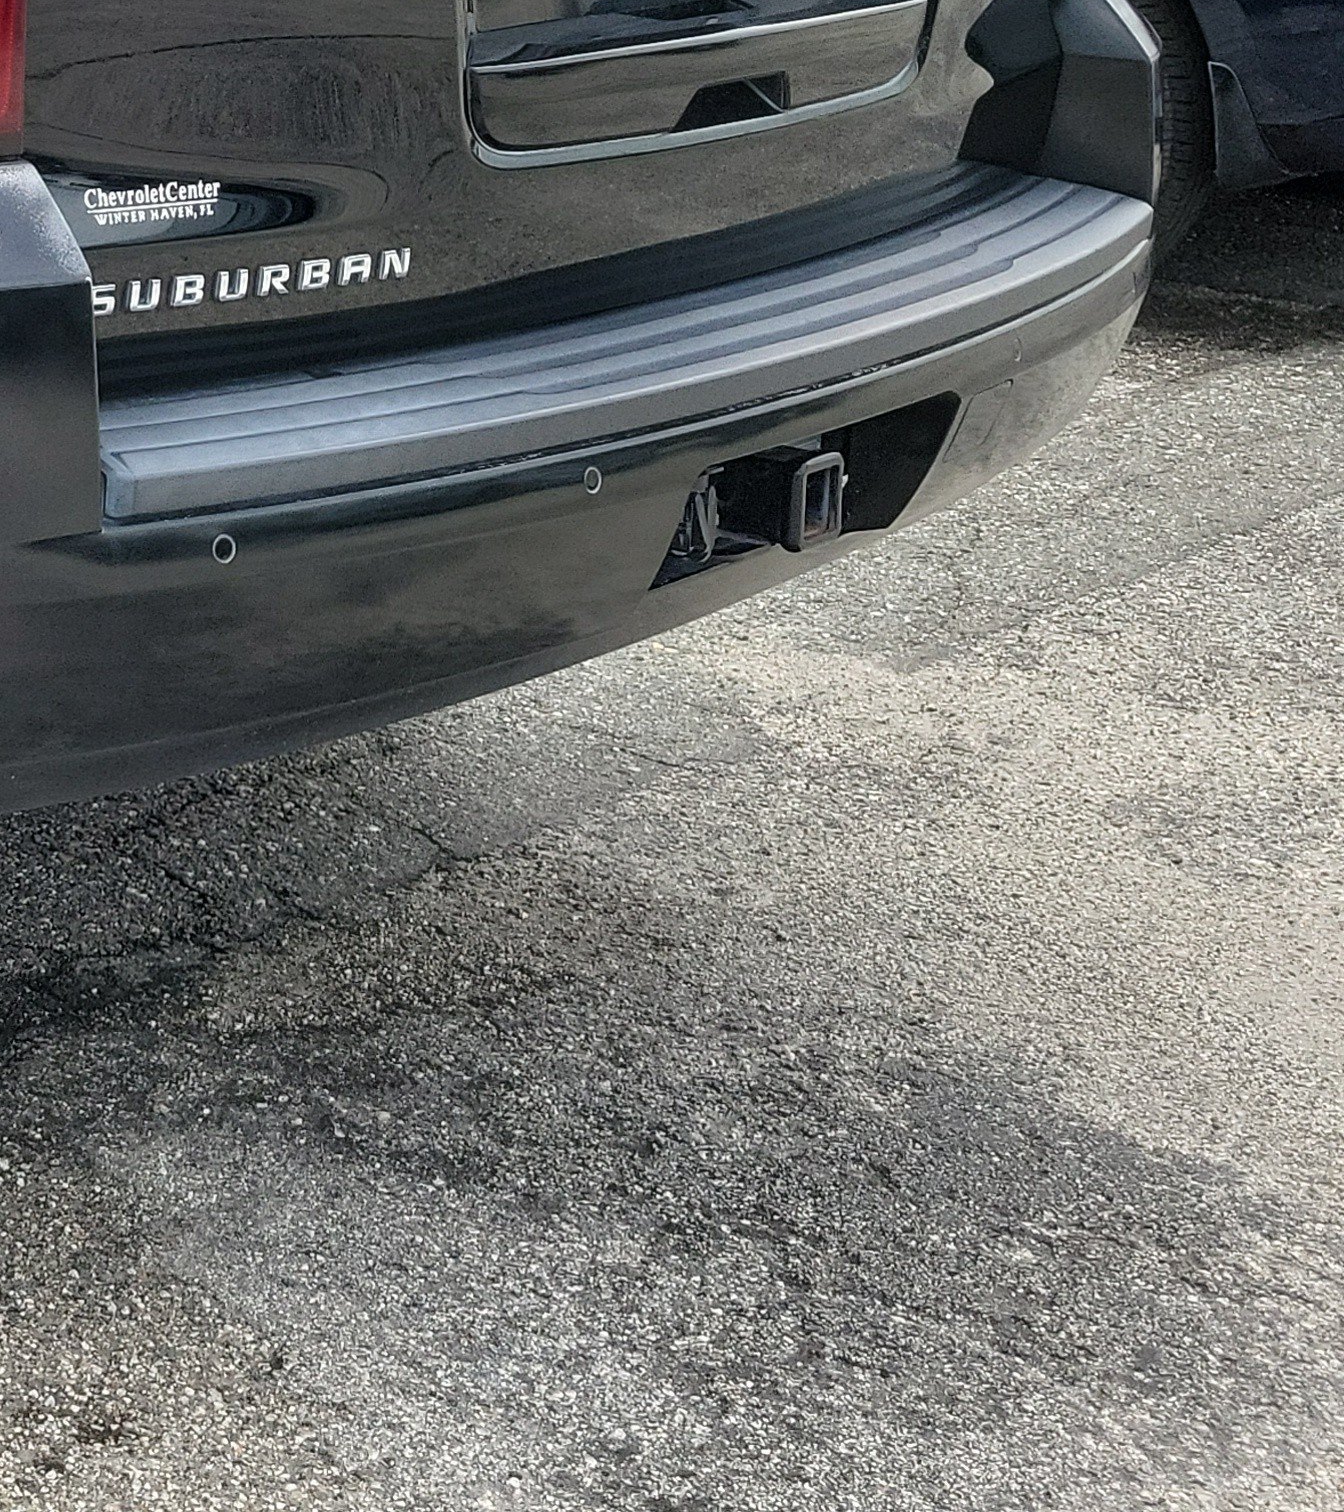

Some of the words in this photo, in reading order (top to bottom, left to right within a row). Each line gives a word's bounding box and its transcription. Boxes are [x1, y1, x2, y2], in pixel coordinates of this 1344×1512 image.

[93, 209, 146, 226] WINTER
[150, 204, 197, 221] HAVEN,
[199, 202, 215, 216] FL
[91, 247, 411, 317] SUBURBAN
